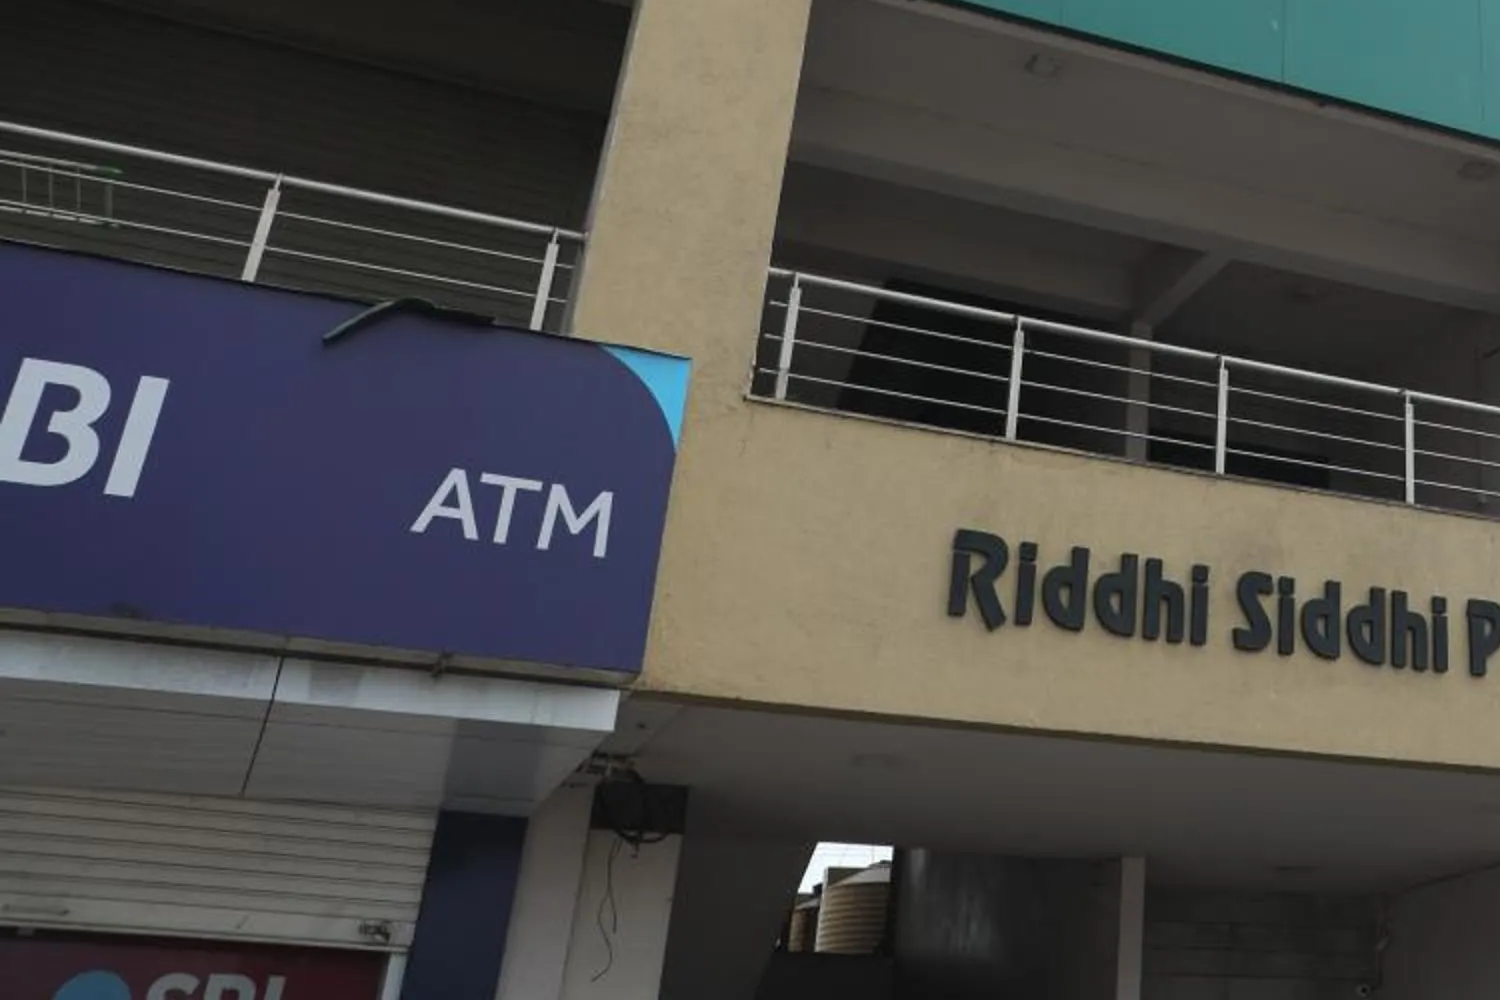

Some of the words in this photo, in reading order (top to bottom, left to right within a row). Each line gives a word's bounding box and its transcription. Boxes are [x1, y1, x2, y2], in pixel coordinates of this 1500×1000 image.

[410, 467, 614, 558] ATM
[947, 528, 1210, 646] Riddhi
[1230, 570, 1449, 674] Siddhi
